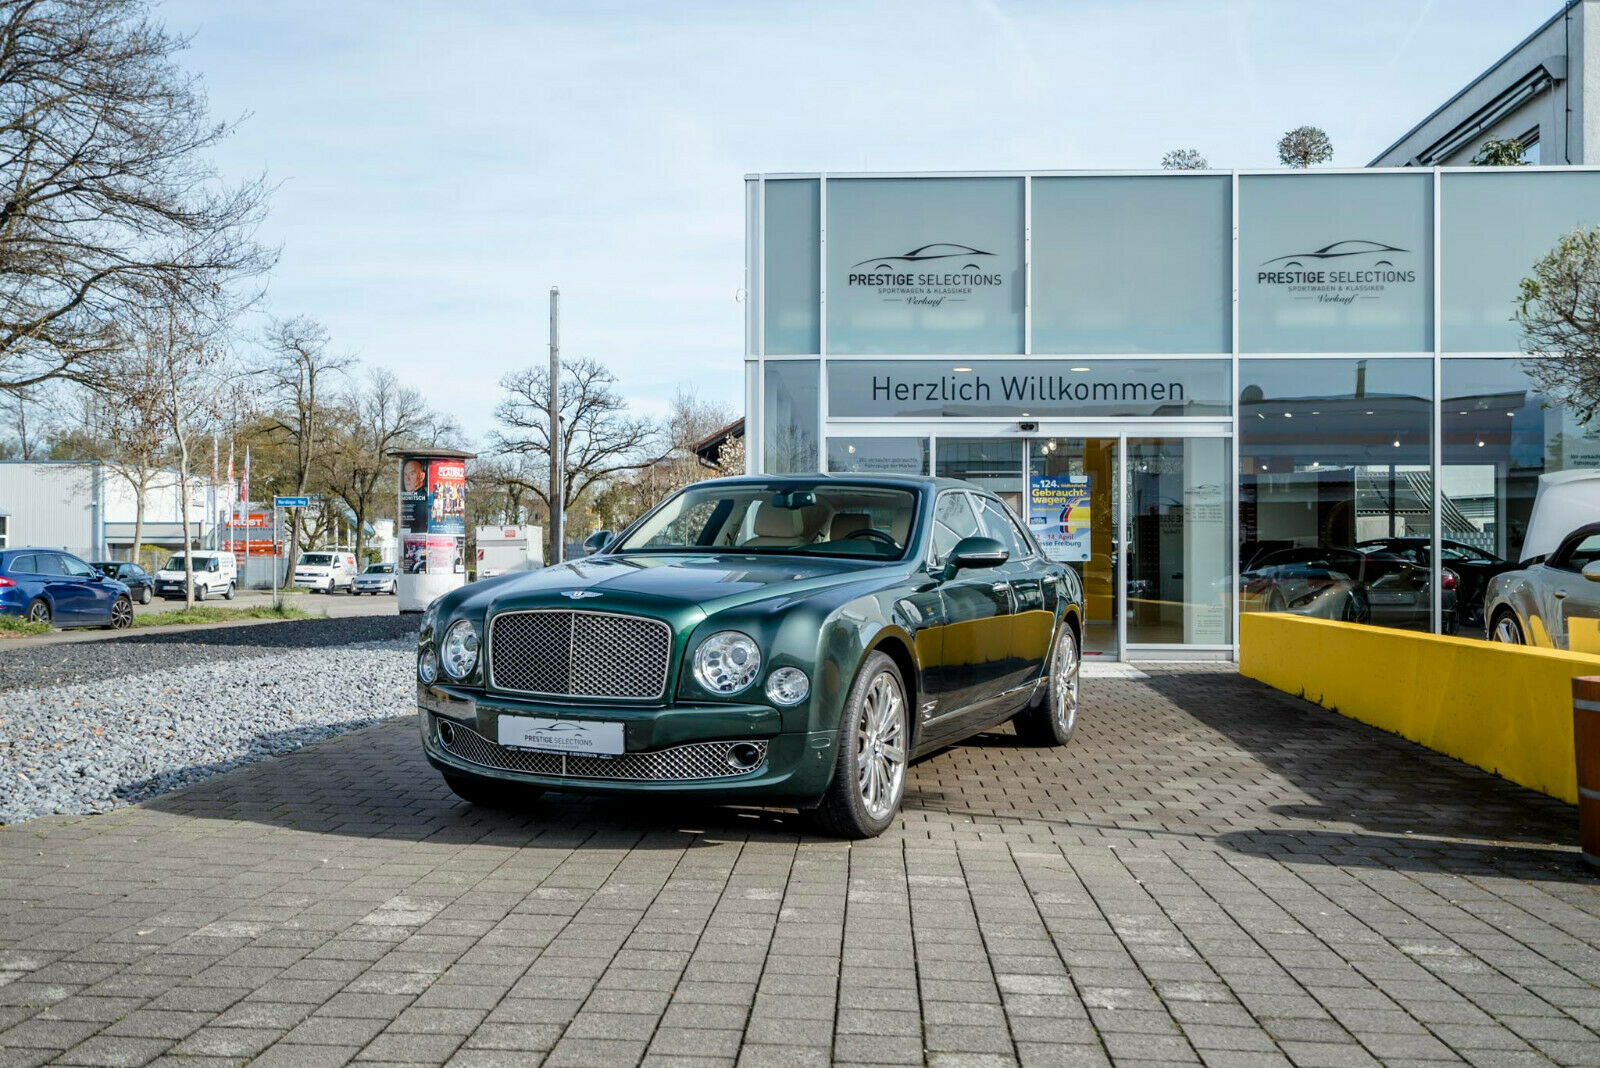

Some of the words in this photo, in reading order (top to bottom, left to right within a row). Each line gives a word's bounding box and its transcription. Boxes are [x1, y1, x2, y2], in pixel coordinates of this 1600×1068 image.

[848, 273, 914, 286] PRESTIGE
[918, 273, 1002, 286] SELECTIONS
[1257, 271, 1325, 284] PRESTIGE
[1329, 270, 1416, 283] SELECTIONS
[905, 296, 945, 307] Verkauf
[1317, 294, 1358, 305] Verkauf
[872, 375, 991, 401] Herzlich
[1001, 375, 1185, 401] Willkommen
[1040, 480, 1060, 488] 124.
[1032, 488, 1087, 497] Gebraucht-
[1032, 496, 1066, 505] wagen
[1054, 540, 1082, 548] Freiburg
[524, 734, 554, 744] PRESTIGE
[554, 737, 593, 747] SELECTIONS
